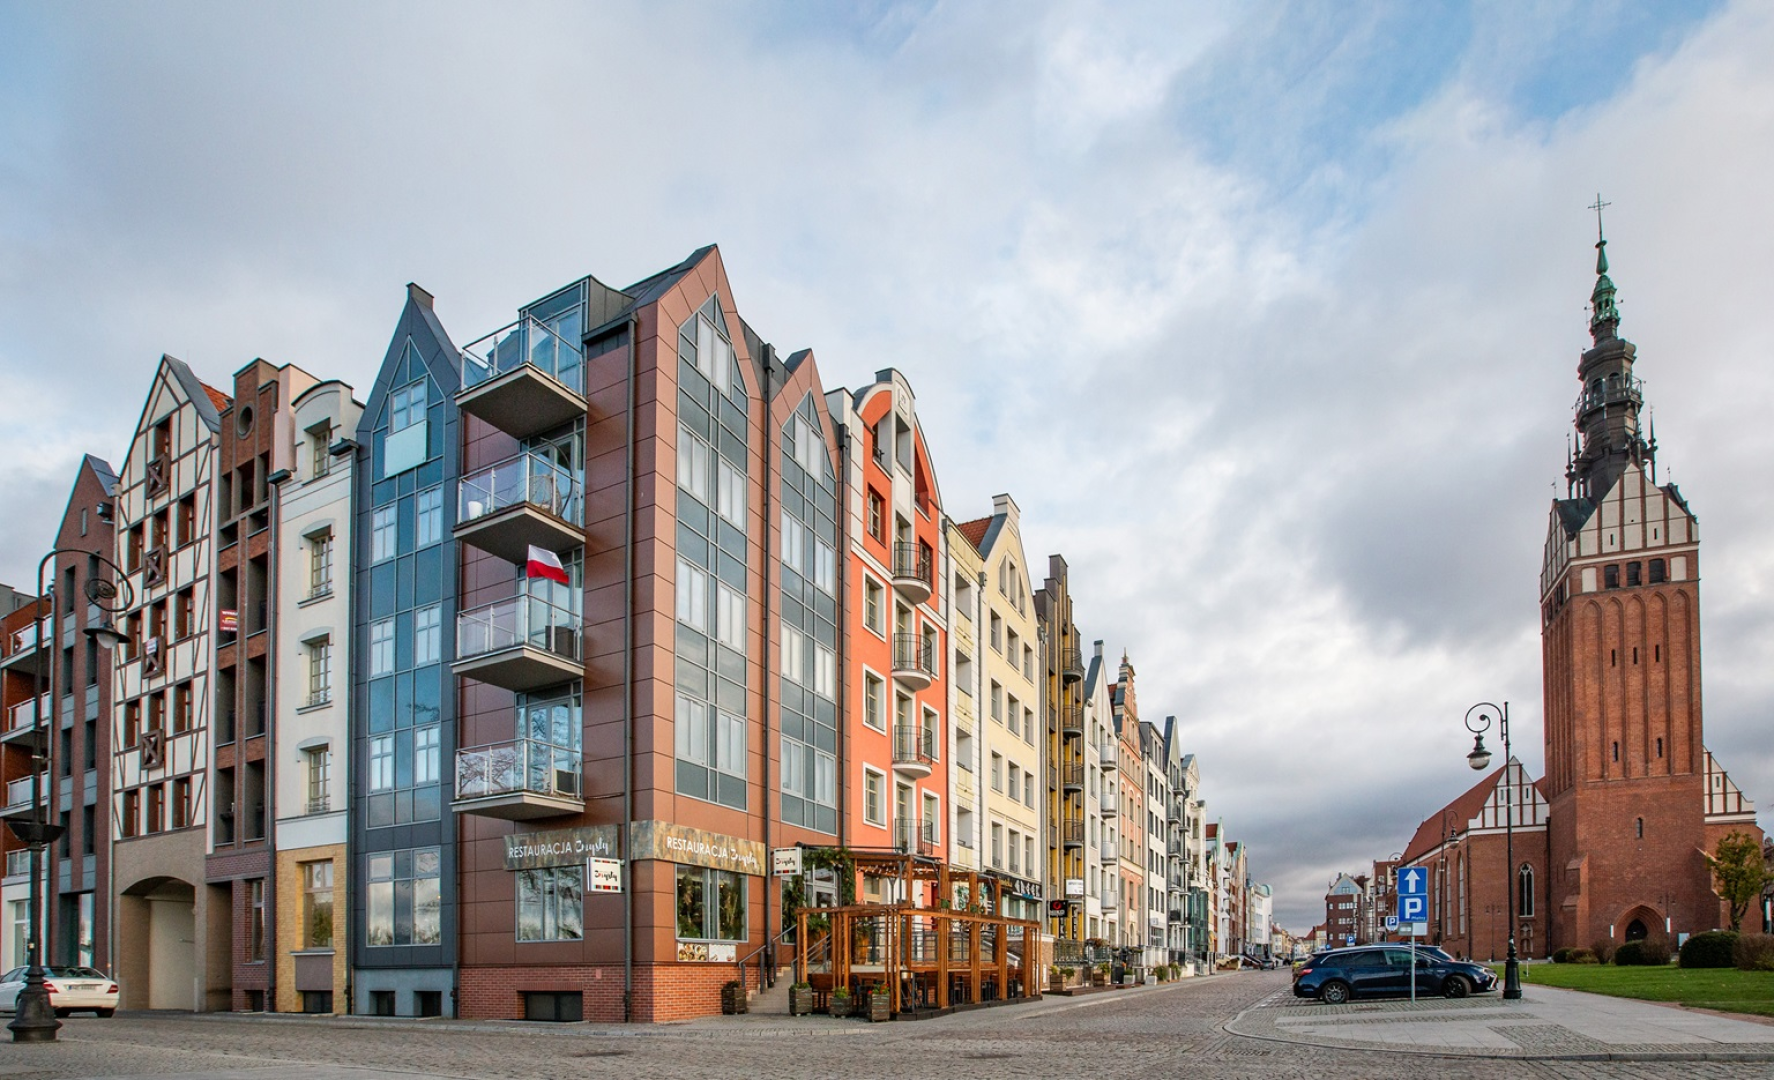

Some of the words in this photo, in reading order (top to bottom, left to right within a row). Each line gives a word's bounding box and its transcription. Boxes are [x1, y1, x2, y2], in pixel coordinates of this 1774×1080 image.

[508, 841, 573, 859] RESTAURACJA
[666, 836, 728, 858] RESTAURACJA
[1405, 898, 1422, 919] P
